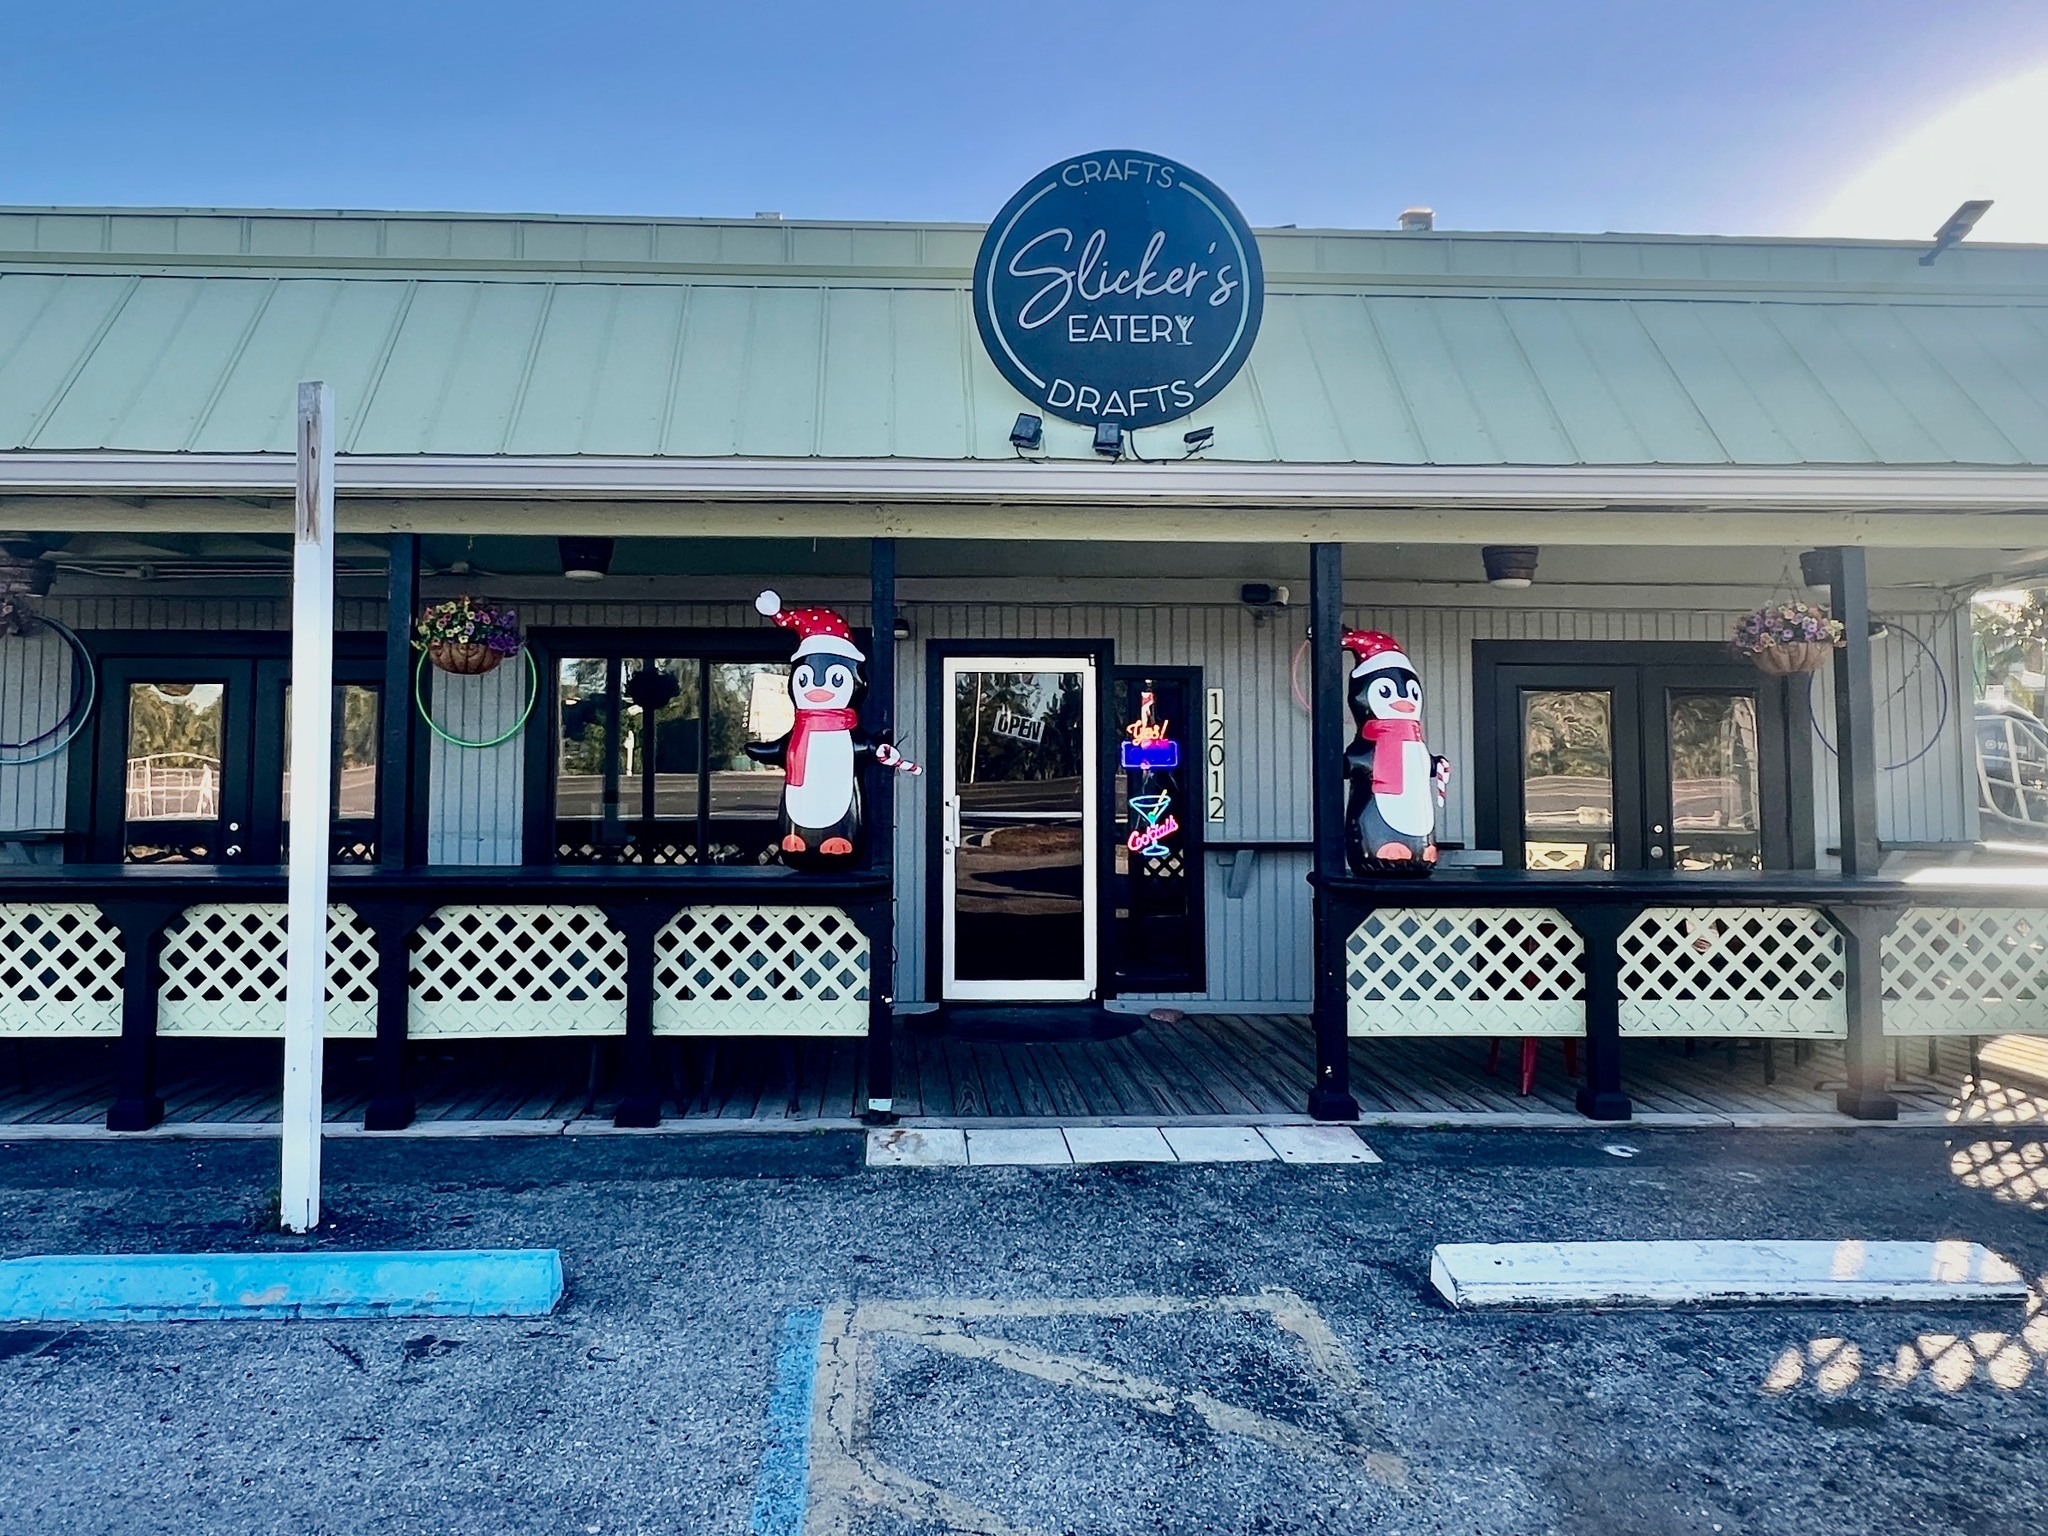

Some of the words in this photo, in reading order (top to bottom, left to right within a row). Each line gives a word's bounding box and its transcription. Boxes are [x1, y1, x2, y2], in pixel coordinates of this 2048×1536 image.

[1061, 158, 1176, 189] CRAFTS
[1008, 227, 1239, 330] Slicker's
[1067, 314, 1195, 346] EATERY
[1046, 378, 1195, 417] DRAFTS
[997, 712, 1042, 741] OPEN
[1208, 692, 1225, 820] 12012
